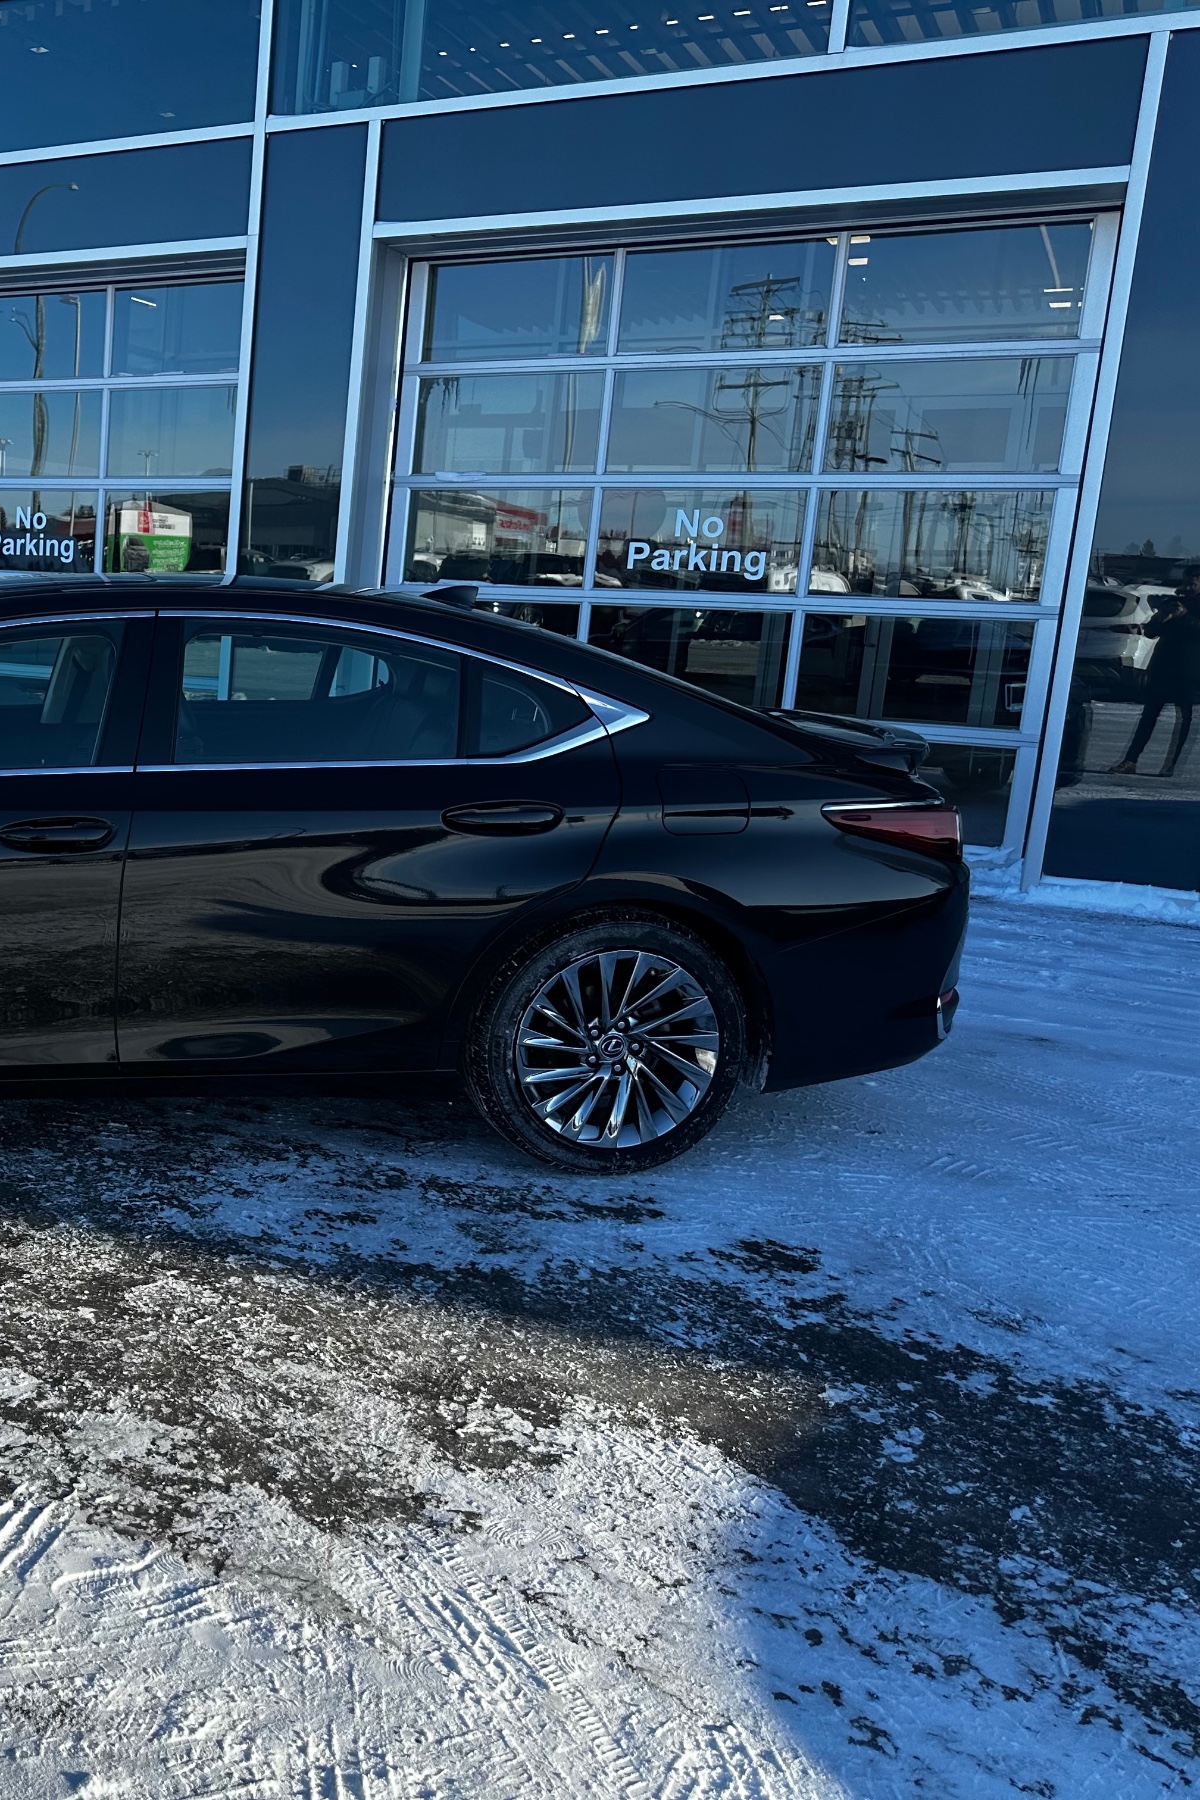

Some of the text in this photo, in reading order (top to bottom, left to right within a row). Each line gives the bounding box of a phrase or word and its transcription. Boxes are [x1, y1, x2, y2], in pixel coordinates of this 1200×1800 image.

[15, 506, 47, 530] No
[674, 509, 724, 538] No
[626, 541, 767, 581] Parking
